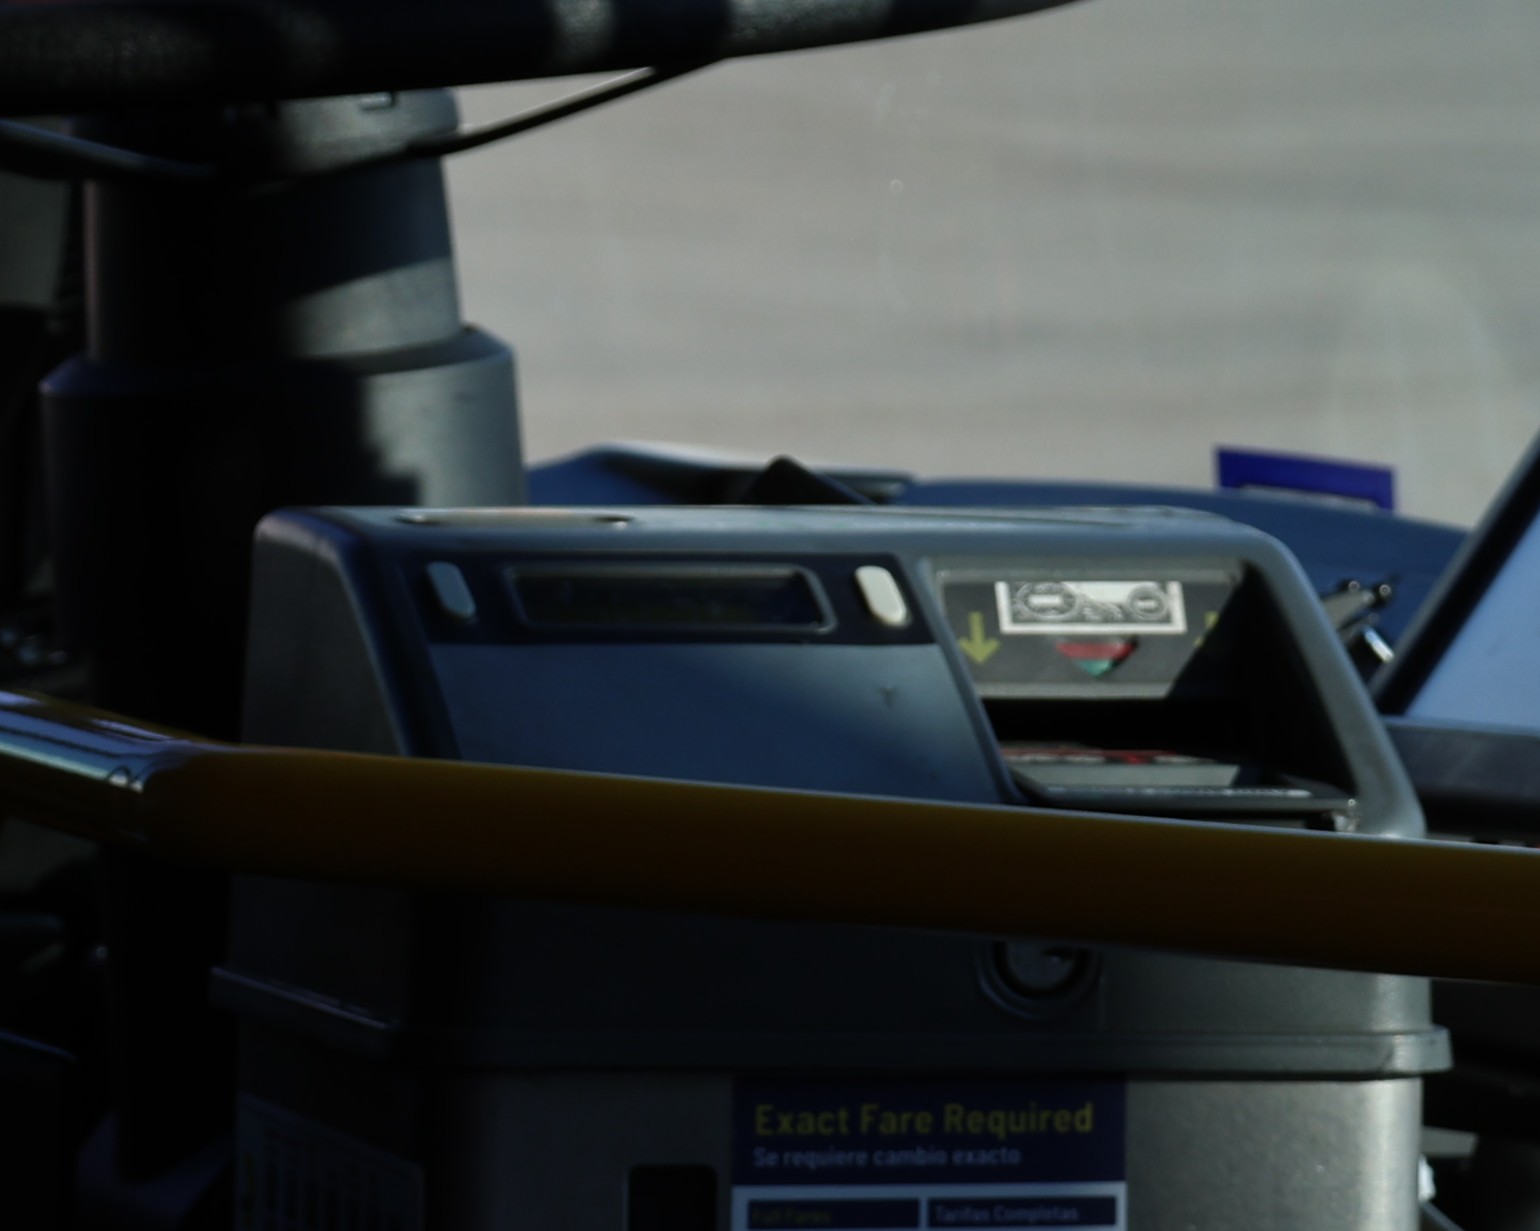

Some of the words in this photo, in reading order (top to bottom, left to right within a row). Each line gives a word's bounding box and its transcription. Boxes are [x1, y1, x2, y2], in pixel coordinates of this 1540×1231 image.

[755, 1103, 850, 1136] Exact
[860, 1102, 934, 1135] Fare
[944, 1099, 1094, 1141] Required
[753, 1146, 780, 1168] Se
[783, 1145, 869, 1171] requiere
[873, 1144, 948, 1167] cambio
[951, 1145, 1022, 1166] exacto
